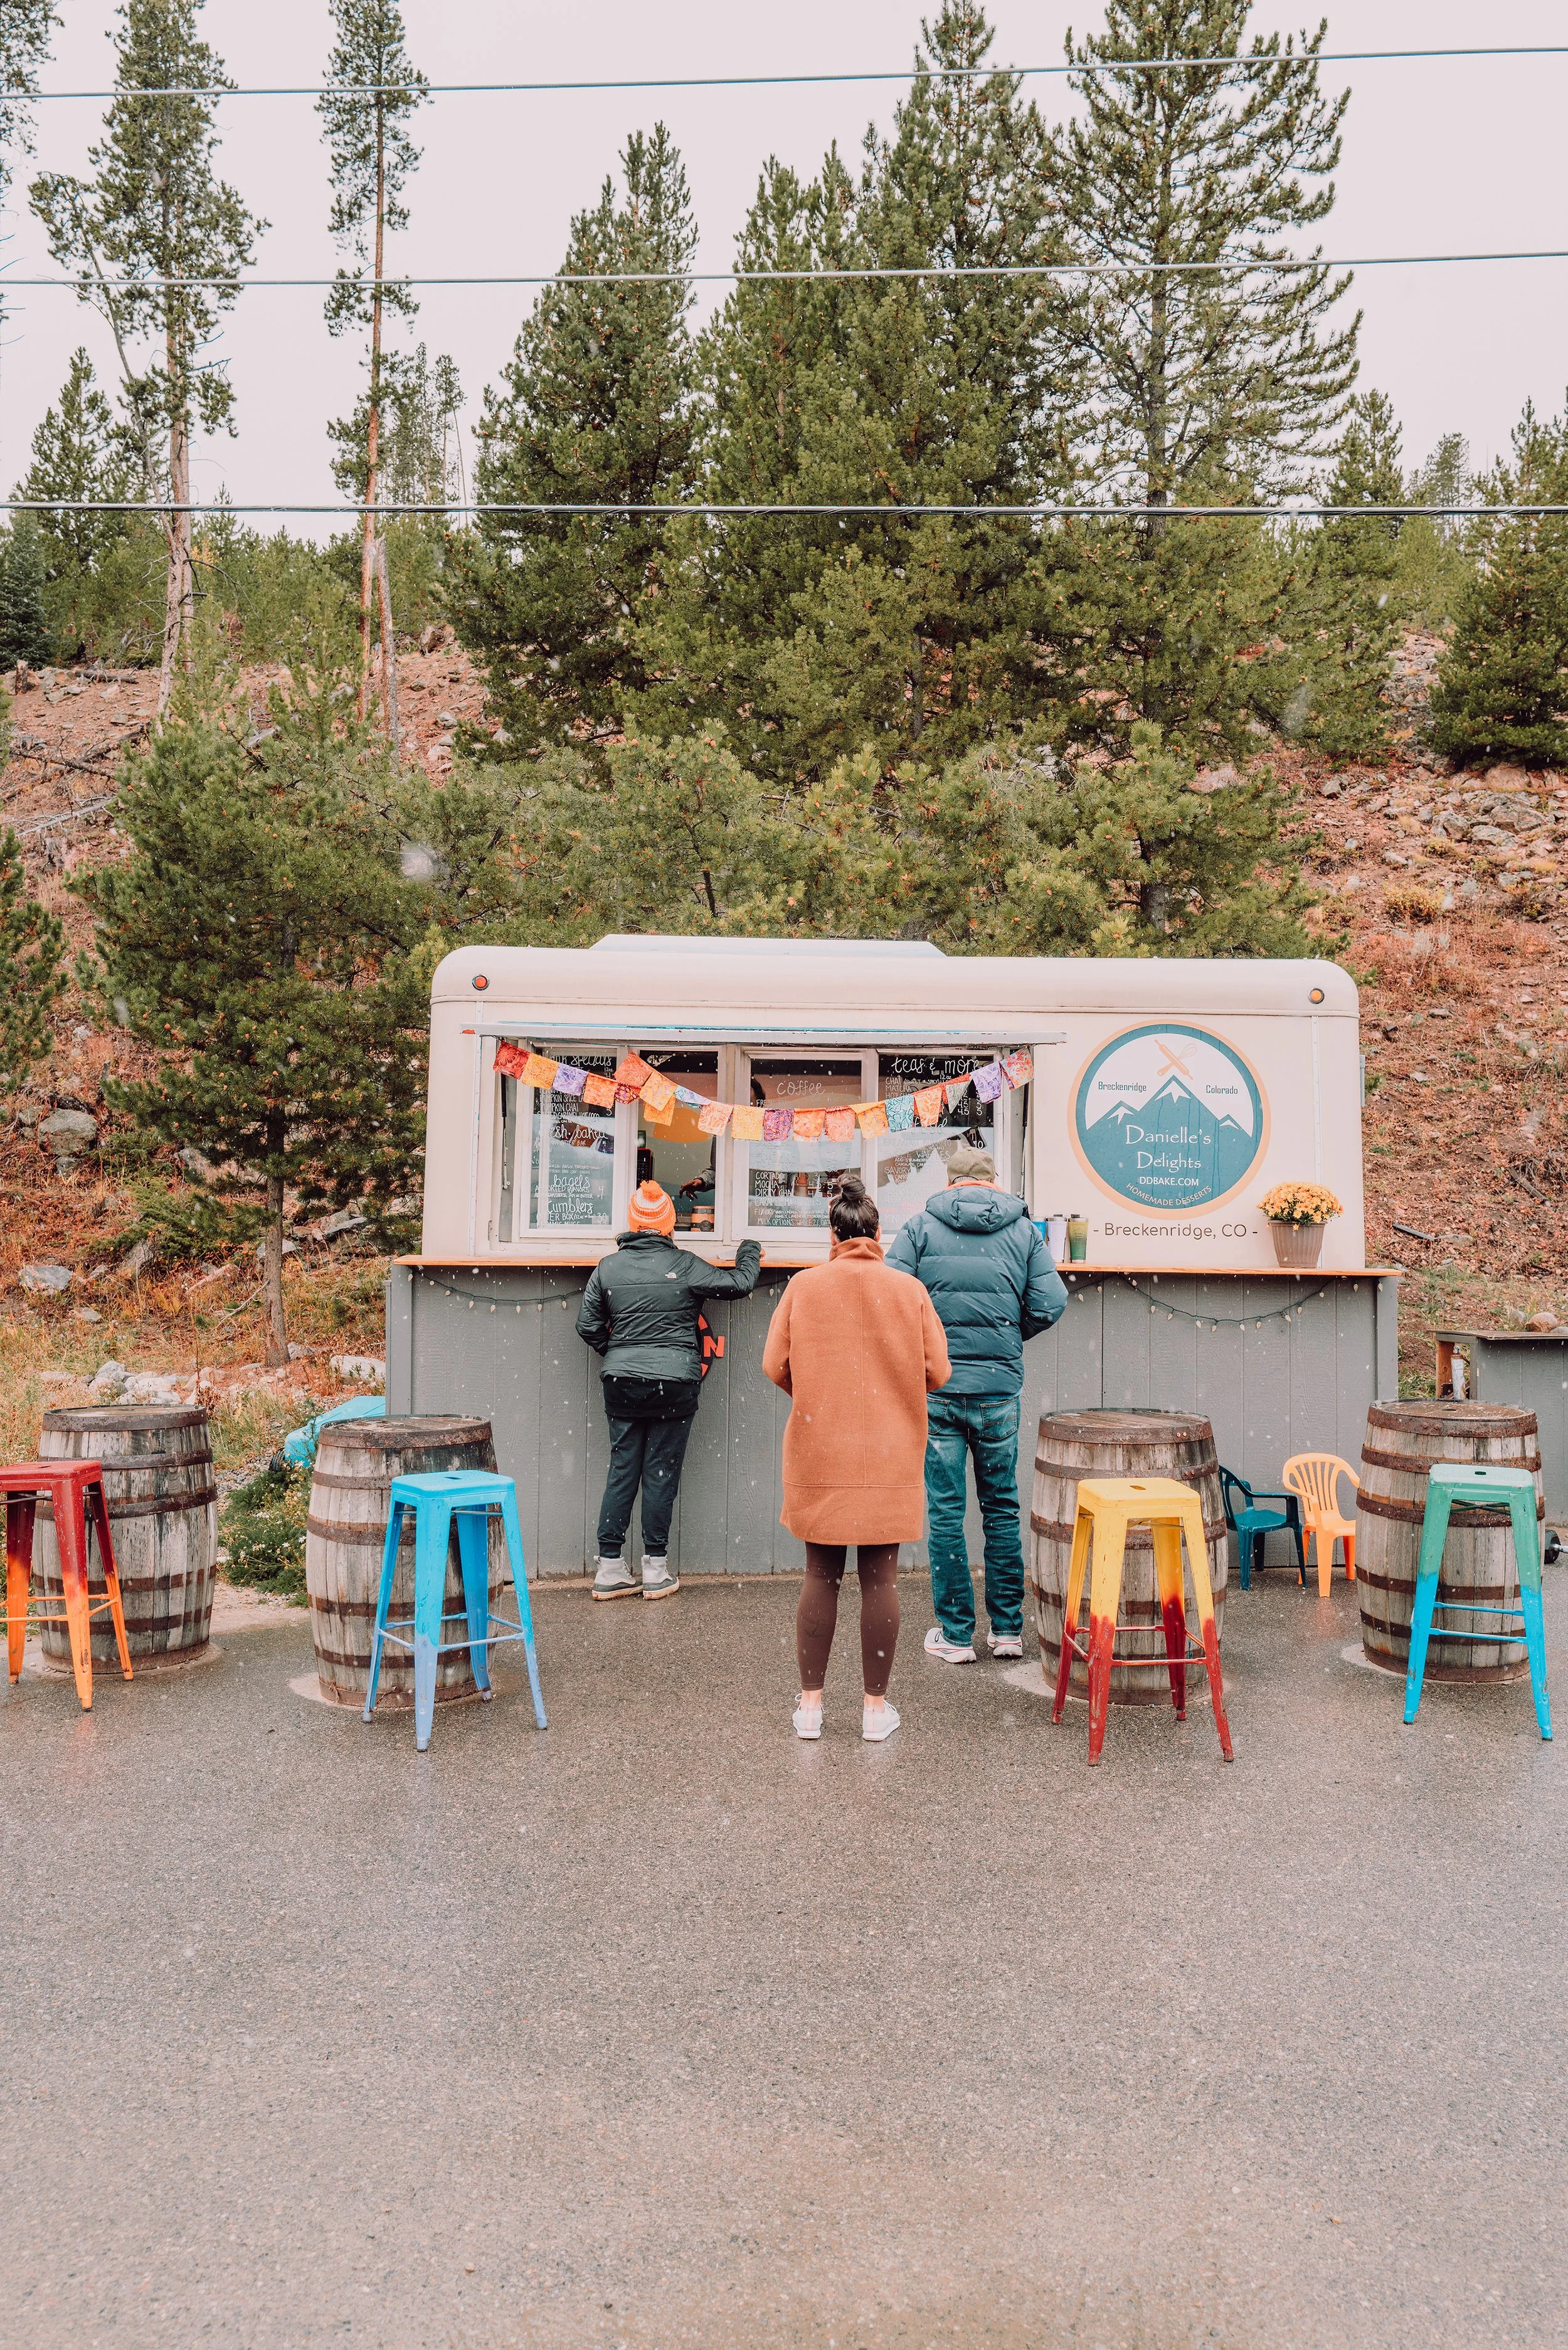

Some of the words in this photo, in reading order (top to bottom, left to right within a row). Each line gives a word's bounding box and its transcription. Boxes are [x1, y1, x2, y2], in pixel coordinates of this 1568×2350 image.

[891, 1056, 926, 1073] teas
[945, 1056, 980, 1075] more
[885, 1077, 902, 1085] CHAI
[1098, 1081, 1147, 1092] Breckenridge
[776, 1080, 826, 1096] coffee
[1205, 1085, 1239, 1095] Colorado
[566, 1103, 578, 1112] CHAI
[1125, 1124, 1212, 1145] Danielle's
[1136, 1151, 1202, 1173] Delights
[755, 1171, 785, 1180] CORTADO
[884, 1166, 911, 1175] SAVORY
[553, 1174, 590, 1193] bagels
[755, 1179, 780, 1189] MOCHA
[1139, 1176, 1199, 1186] DDBAKE.COM
[755, 1188, 776, 1197] DIRTY
[1126, 1183, 1174, 1206] HOMEMADE
[1175, 1185, 1212, 1206] DESSERTS
[547, 1198, 593, 1214] tumblers
[1104, 1223, 1217, 1240] Breckenridge,
[1221, 1223, 1248, 1238] CO
